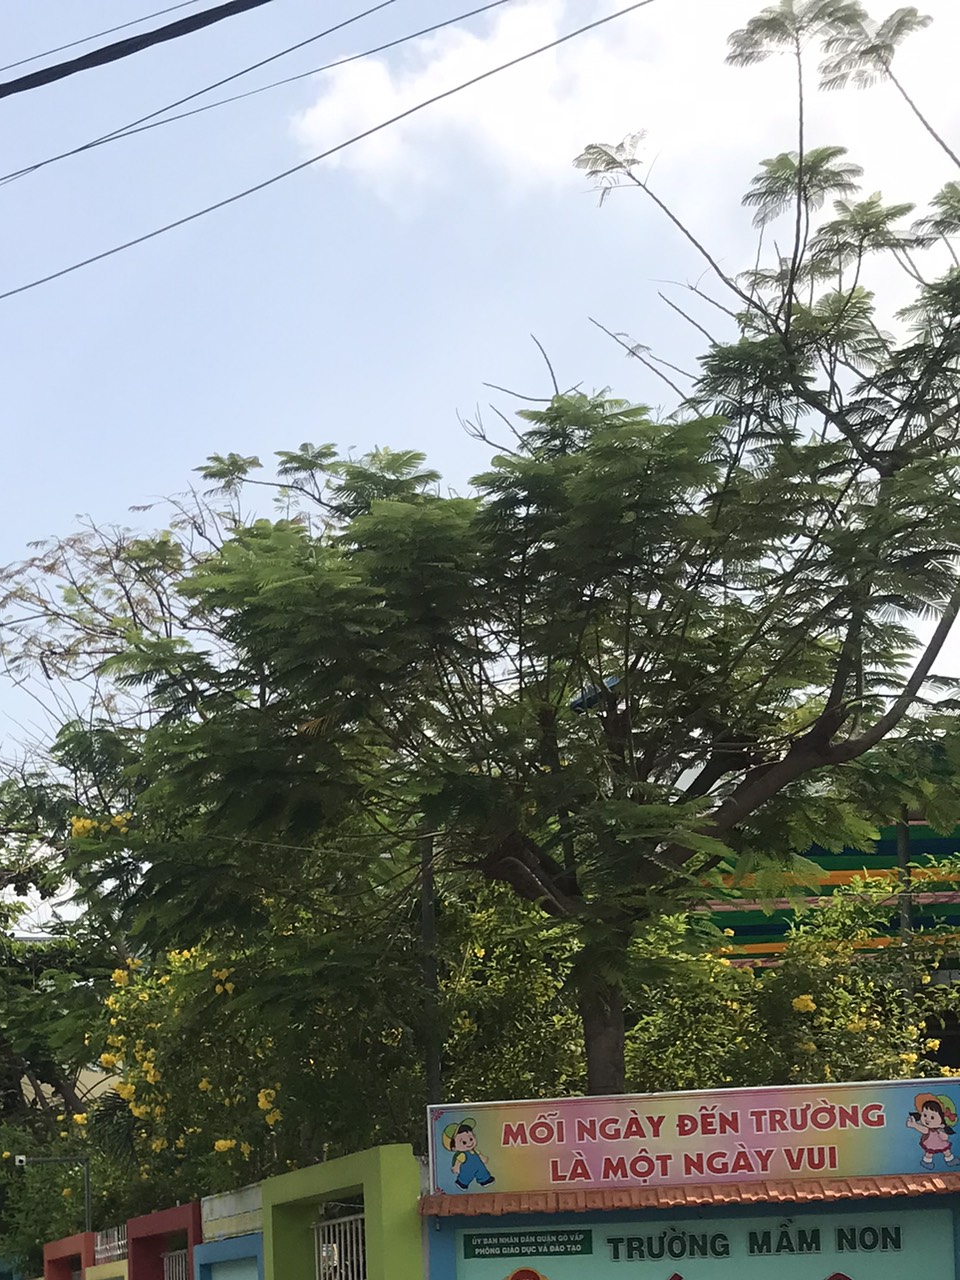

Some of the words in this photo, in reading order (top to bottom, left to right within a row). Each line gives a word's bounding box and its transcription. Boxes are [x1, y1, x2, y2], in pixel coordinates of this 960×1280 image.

[501, 1109, 566, 1147] MỖI
[576, 1109, 665, 1142] NGÀY
[675, 1105, 739, 1139] ĐẾN
[751, 1098, 886, 1134] TRƯỜNG
[550, 1151, 591, 1184] LÀ
[601, 1149, 672, 1184] MỘT
[683, 1143, 775, 1178] NGÀY
[784, 1146, 839, 1172] VUI
[475, 1246, 501, 1255] PHÒNG
[502, 1245, 520, 1254] GIÁO
[521, 1246, 537, 1255] DỤC
[538, 1244, 548, 1253] VÀ
[549, 1244, 565, 1252] ĐÀO
[566, 1244, 582, 1253] TẠO
[499, 1235, 519, 1244] NHÂN
[520, 1235, 536, 1243] DÂN
[536, 1234, 556, 1244] QUẬN
[558, 1233, 568, 1241] GÒ
[569, 1232, 584, 1241] VẤP
[606, 1226, 730, 1261] TRƯỜNG
[748, 1218, 821, 1255] MẦM
[837, 1225, 902, 1252] NON
